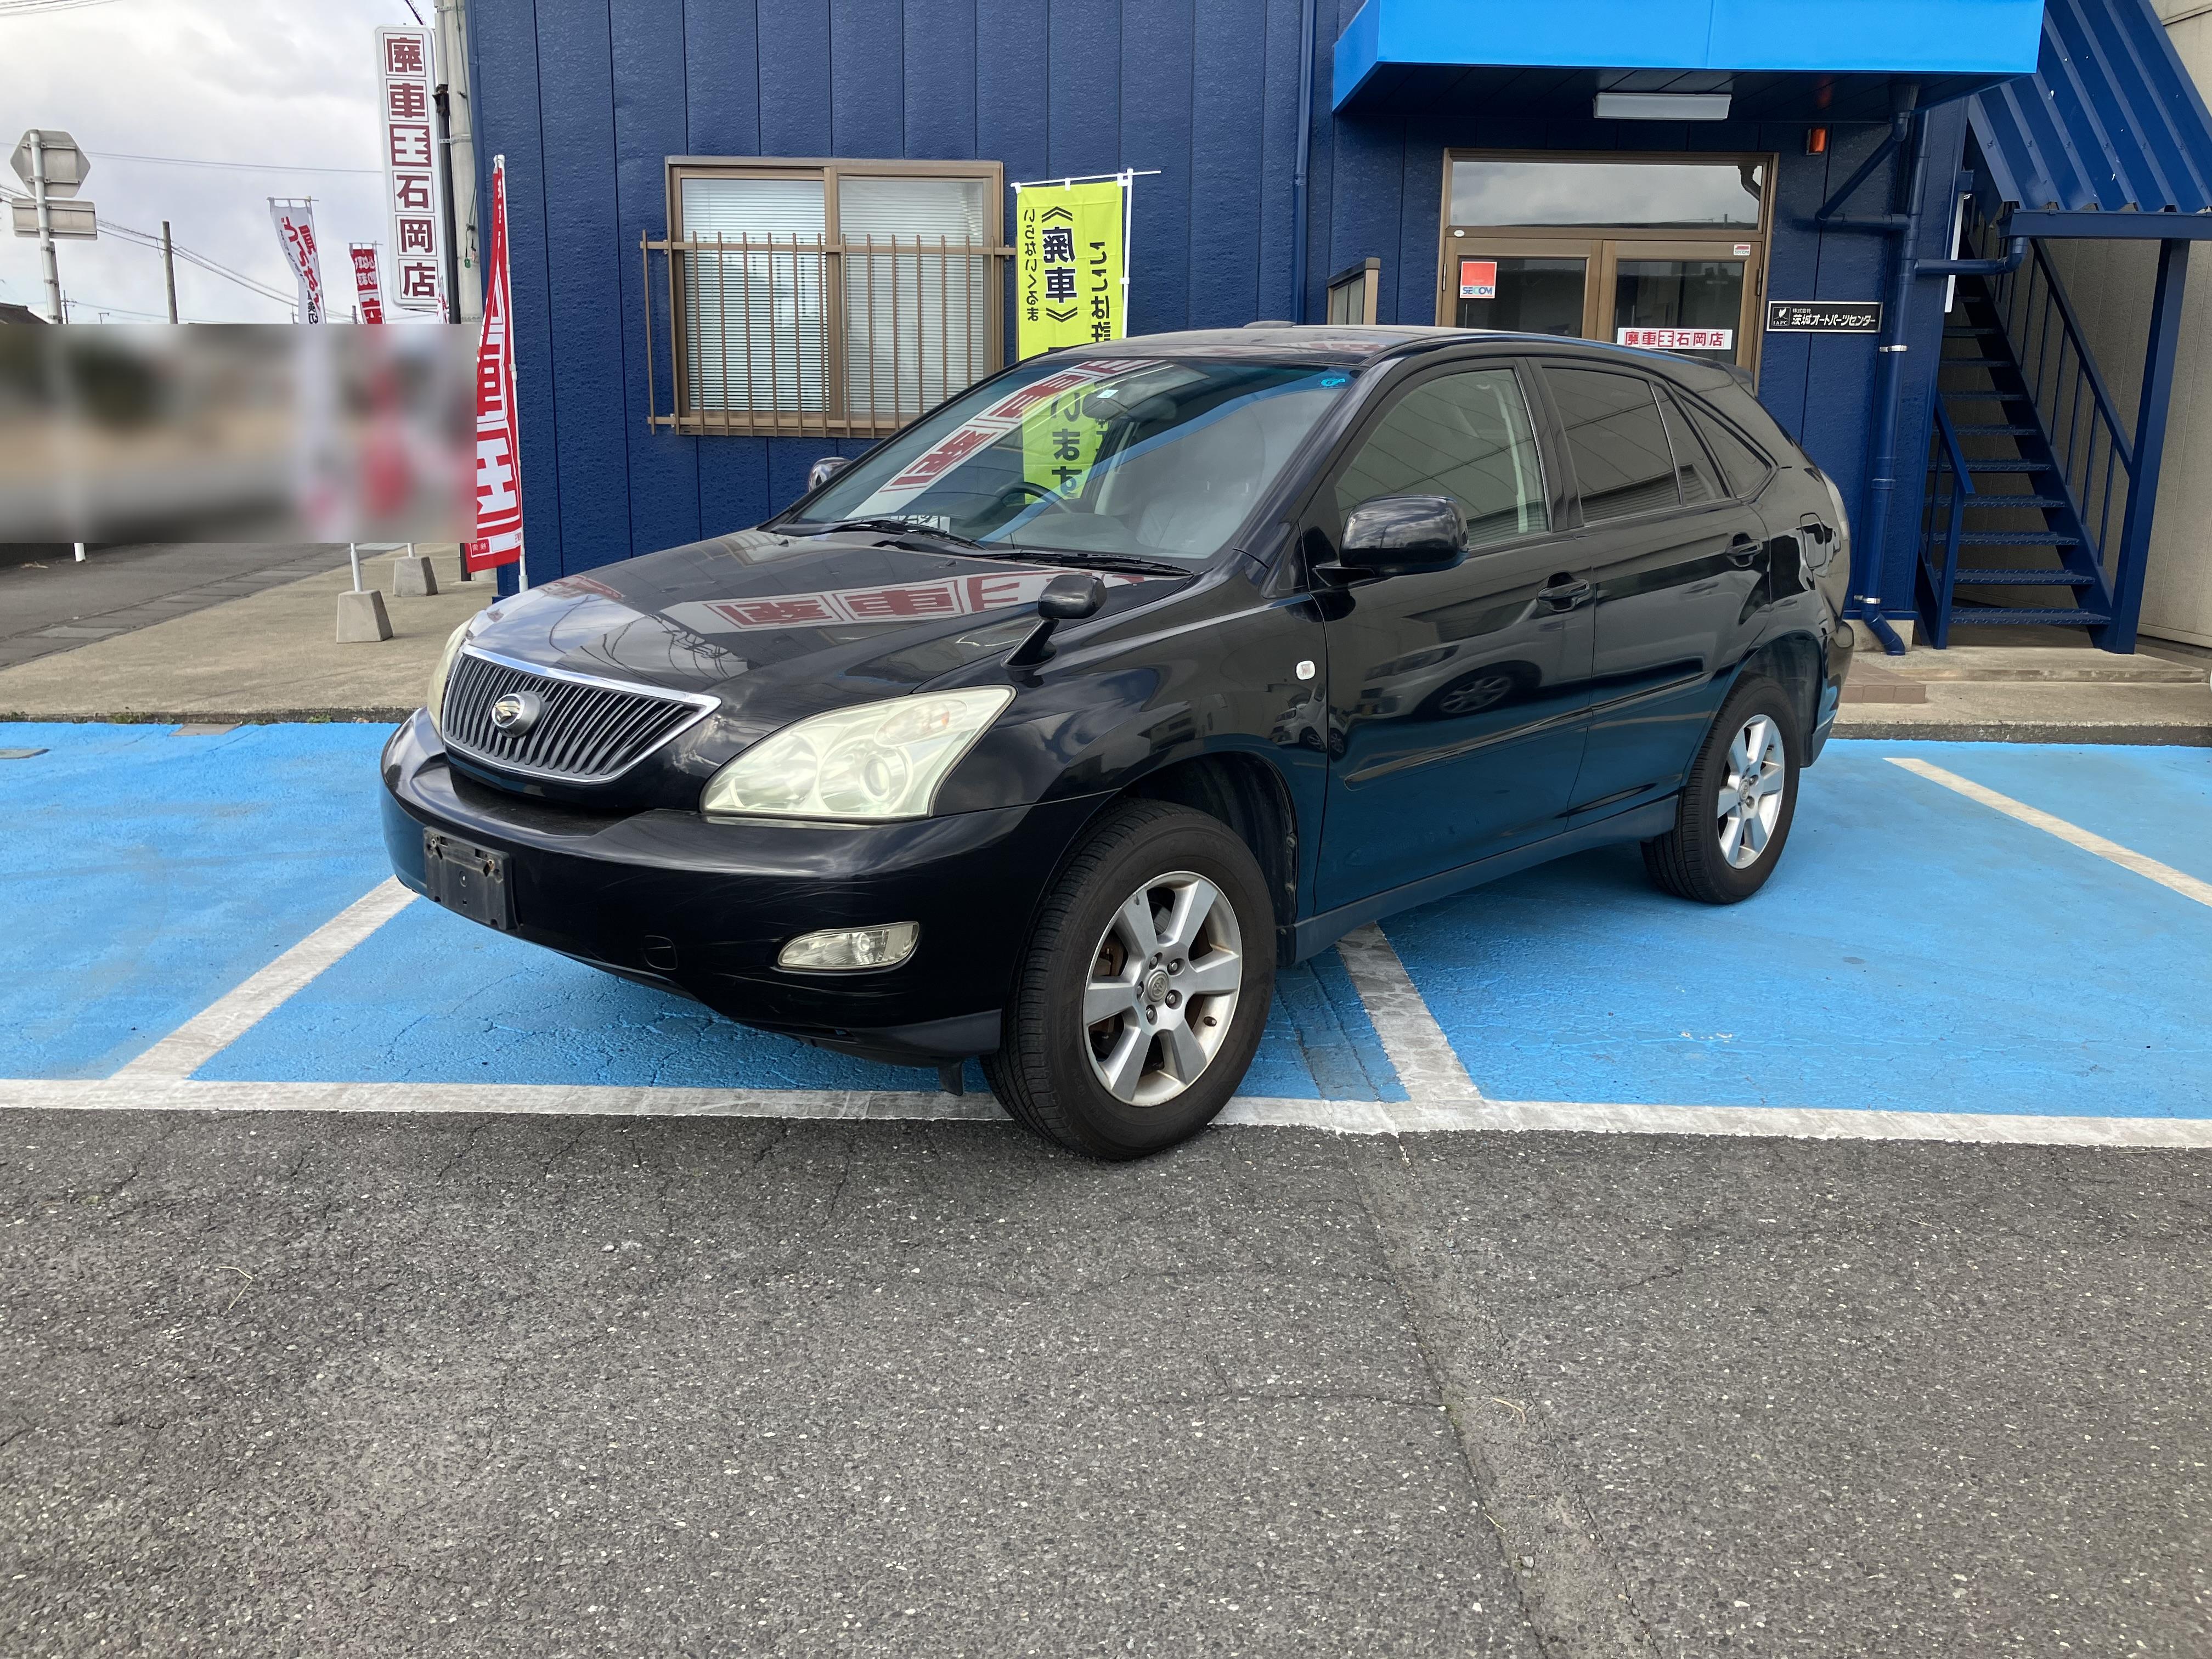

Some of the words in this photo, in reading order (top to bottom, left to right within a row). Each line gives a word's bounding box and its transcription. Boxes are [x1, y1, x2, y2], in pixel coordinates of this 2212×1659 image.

[386, 36, 436, 299] 廃車王石岡店
[1462, 287, 1493, 295] SECOM
[1791, 314, 1876, 326] 茨城オートパーツセンター
[1625, 330, 1724, 347] 廃車王石岡店
